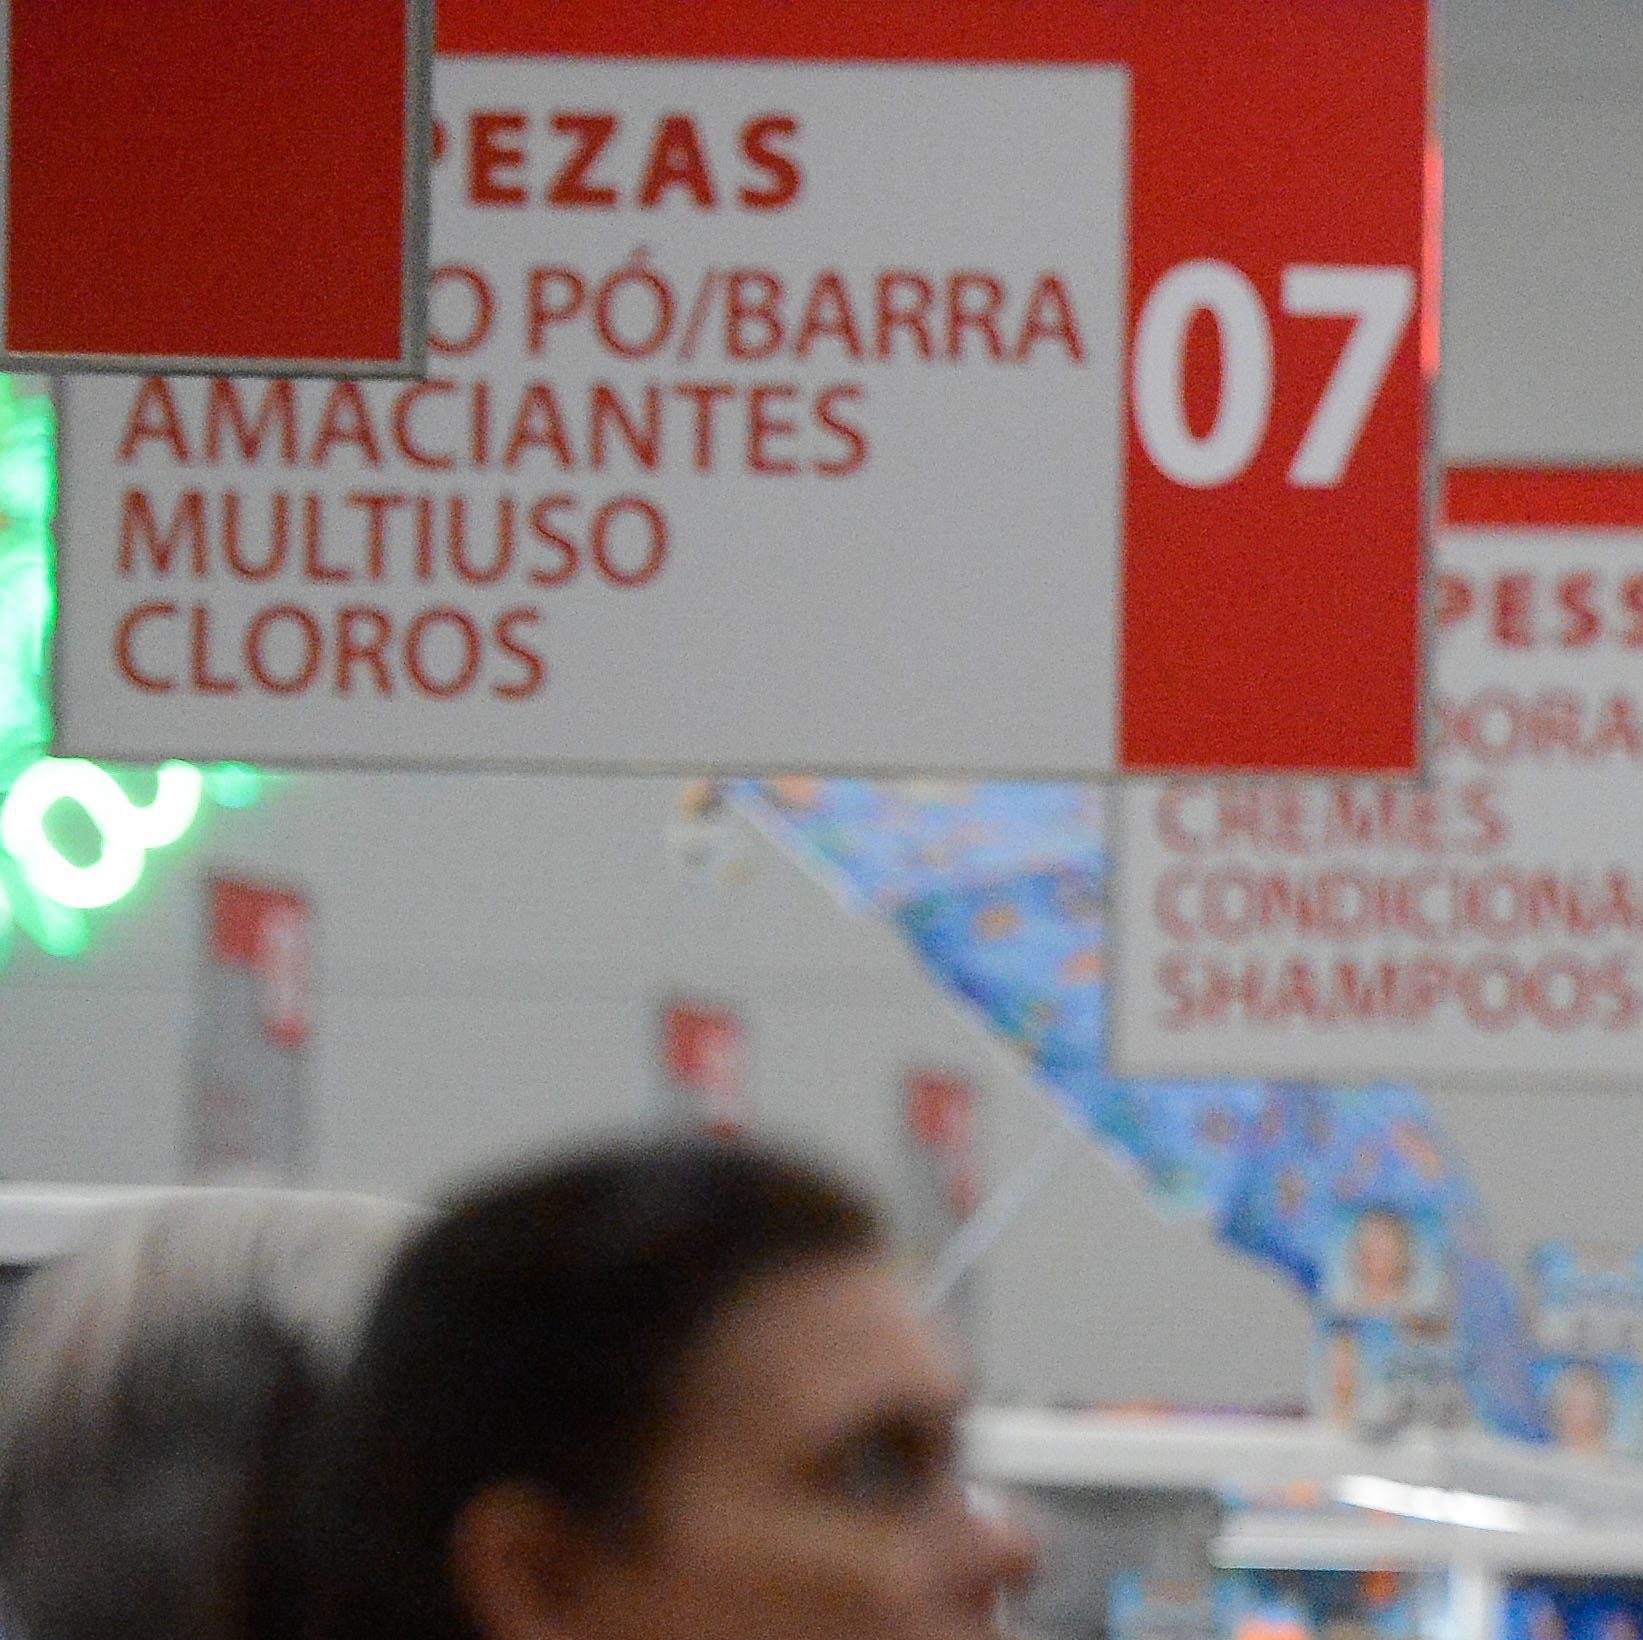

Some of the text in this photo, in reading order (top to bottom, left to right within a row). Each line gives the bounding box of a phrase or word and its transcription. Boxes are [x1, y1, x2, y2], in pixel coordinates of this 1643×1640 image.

[522, 244, 1088, 366] PÓ/BARRA
[1130, 256, 1418, 490] 07
[116, 376, 872, 480] AMACIANTES
[114, 486, 672, 590] MULTIUSO
[110, 600, 550, 704] CLOROS
[1154, 776, 1510, 858] CREMES
